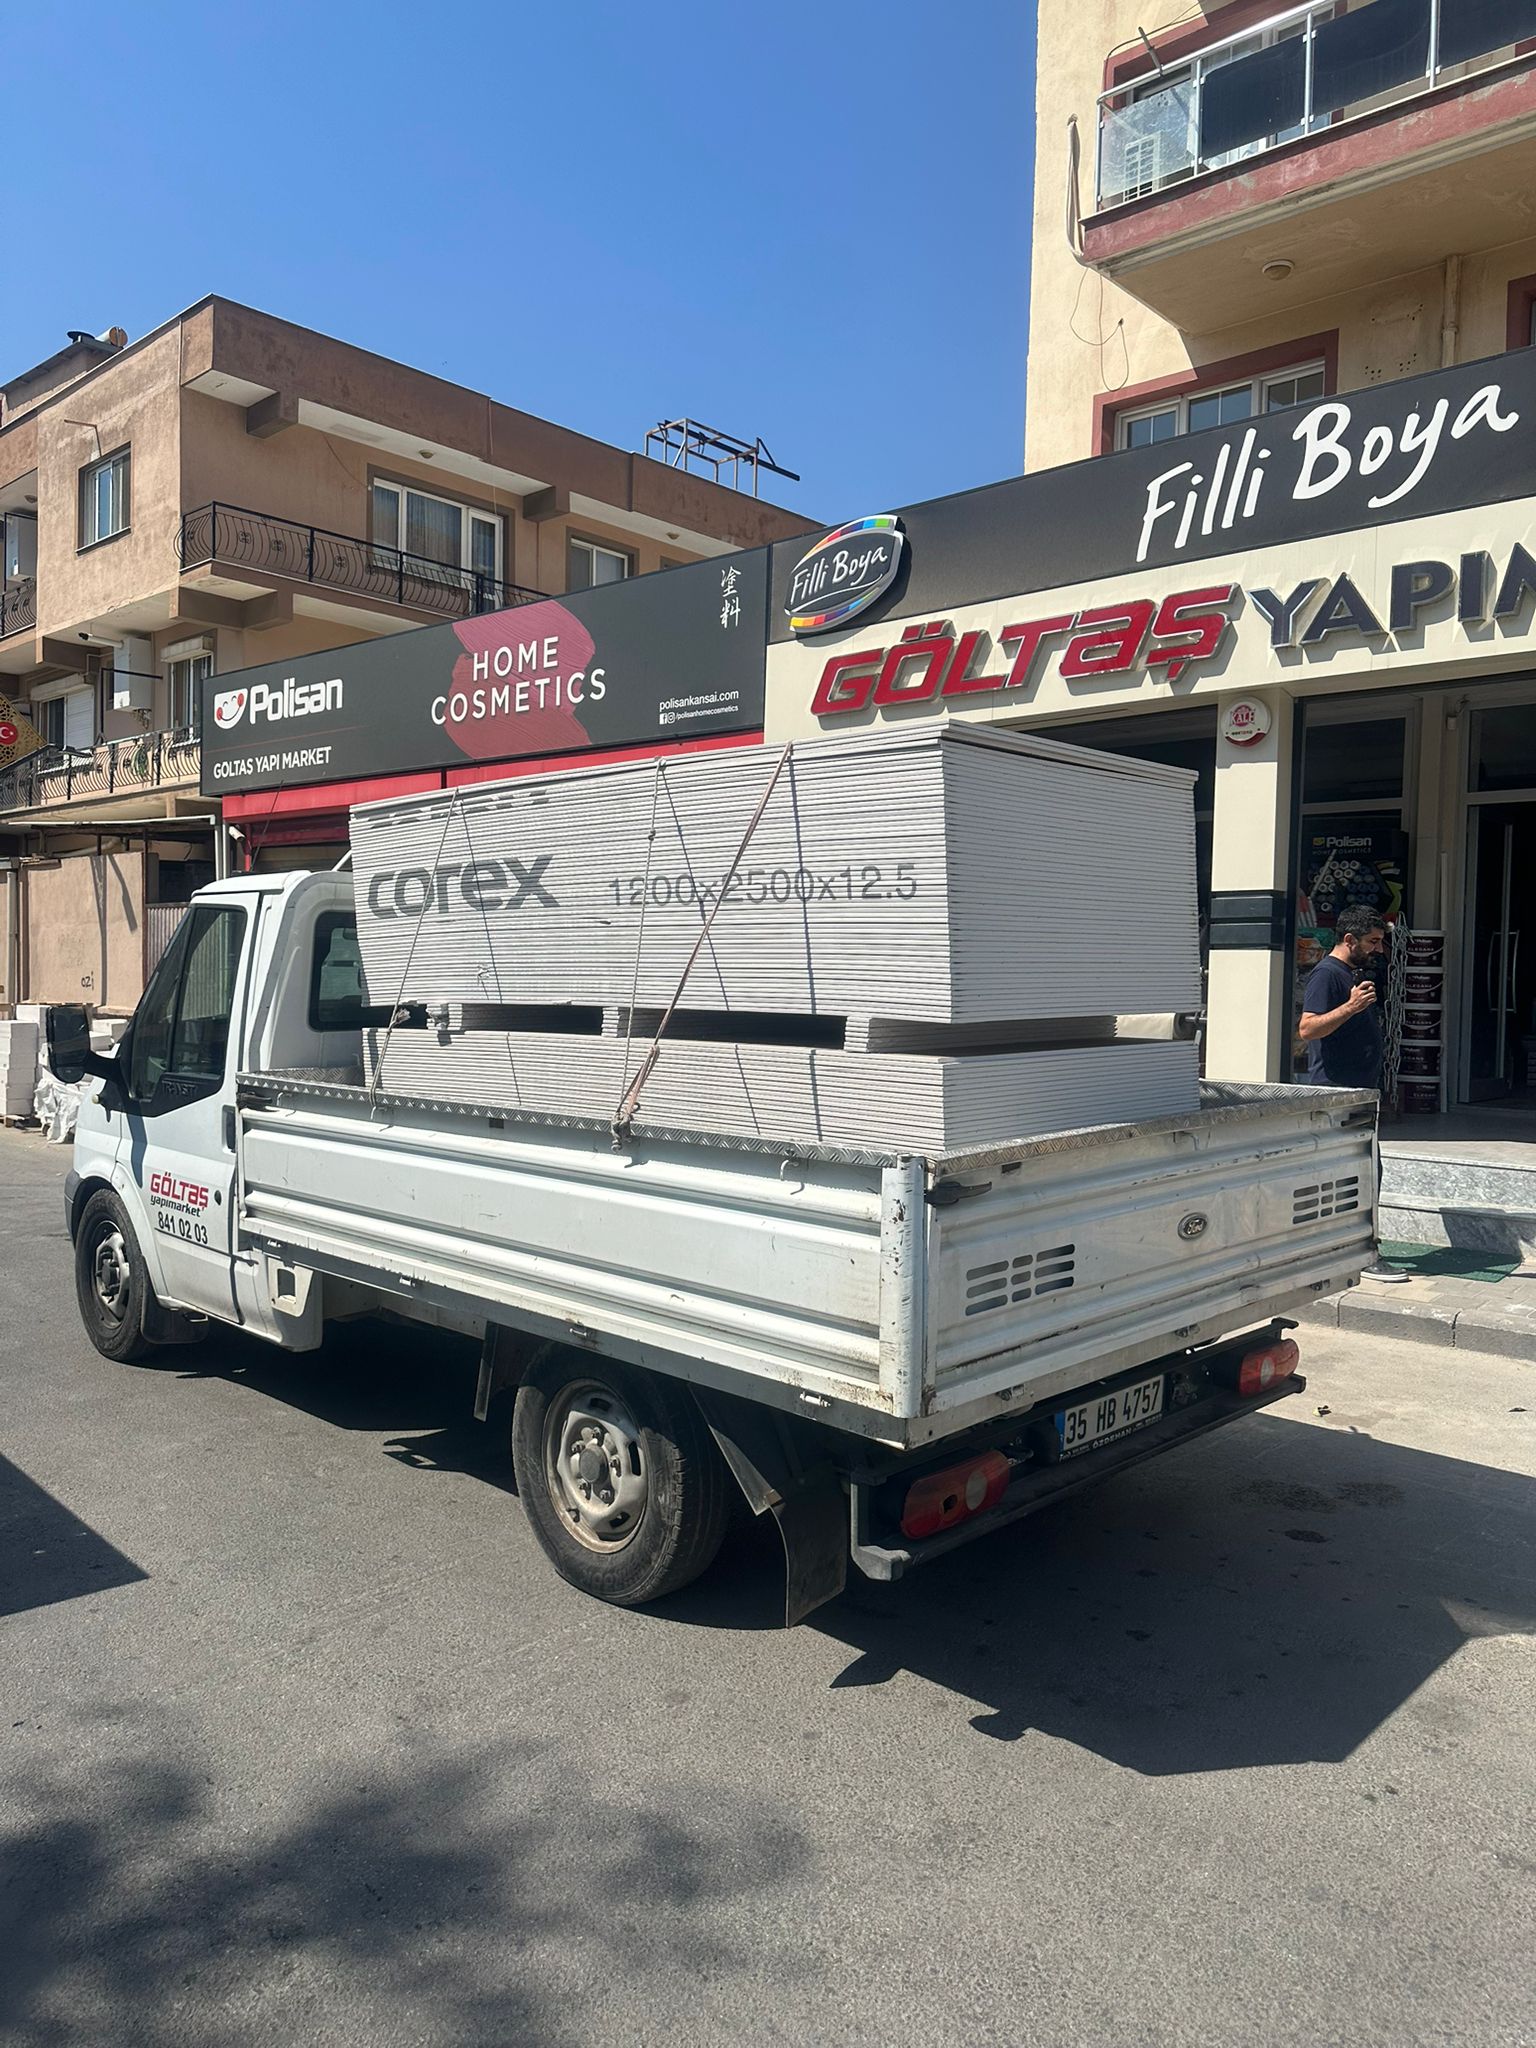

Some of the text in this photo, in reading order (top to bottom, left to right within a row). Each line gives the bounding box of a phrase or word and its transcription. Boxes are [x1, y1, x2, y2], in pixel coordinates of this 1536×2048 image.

[1136, 384, 1519, 562] Filli Boya
[790, 546, 888, 605] Filli Boya
[472, 635, 559, 682] HOME
[249, 677, 343, 725] Polisan
[430, 668, 606, 726] COSMETICS
[659, 690, 740, 712] polisankansai.com
[255, 754, 280, 773] YAPI
[282, 746, 332, 770] MARKET
[1326, 836, 1372, 848] Polisan
[367, 854, 561, 920] corex
[609, 863, 918, 907] 1200x2500x12.5
[158, 1211, 208, 1245] 841 02 03
[1065, 1408, 1088, 1445] 35
[1096, 1397, 1117, 1434] HB
[1122, 1380, 1161, 1421] 4757
